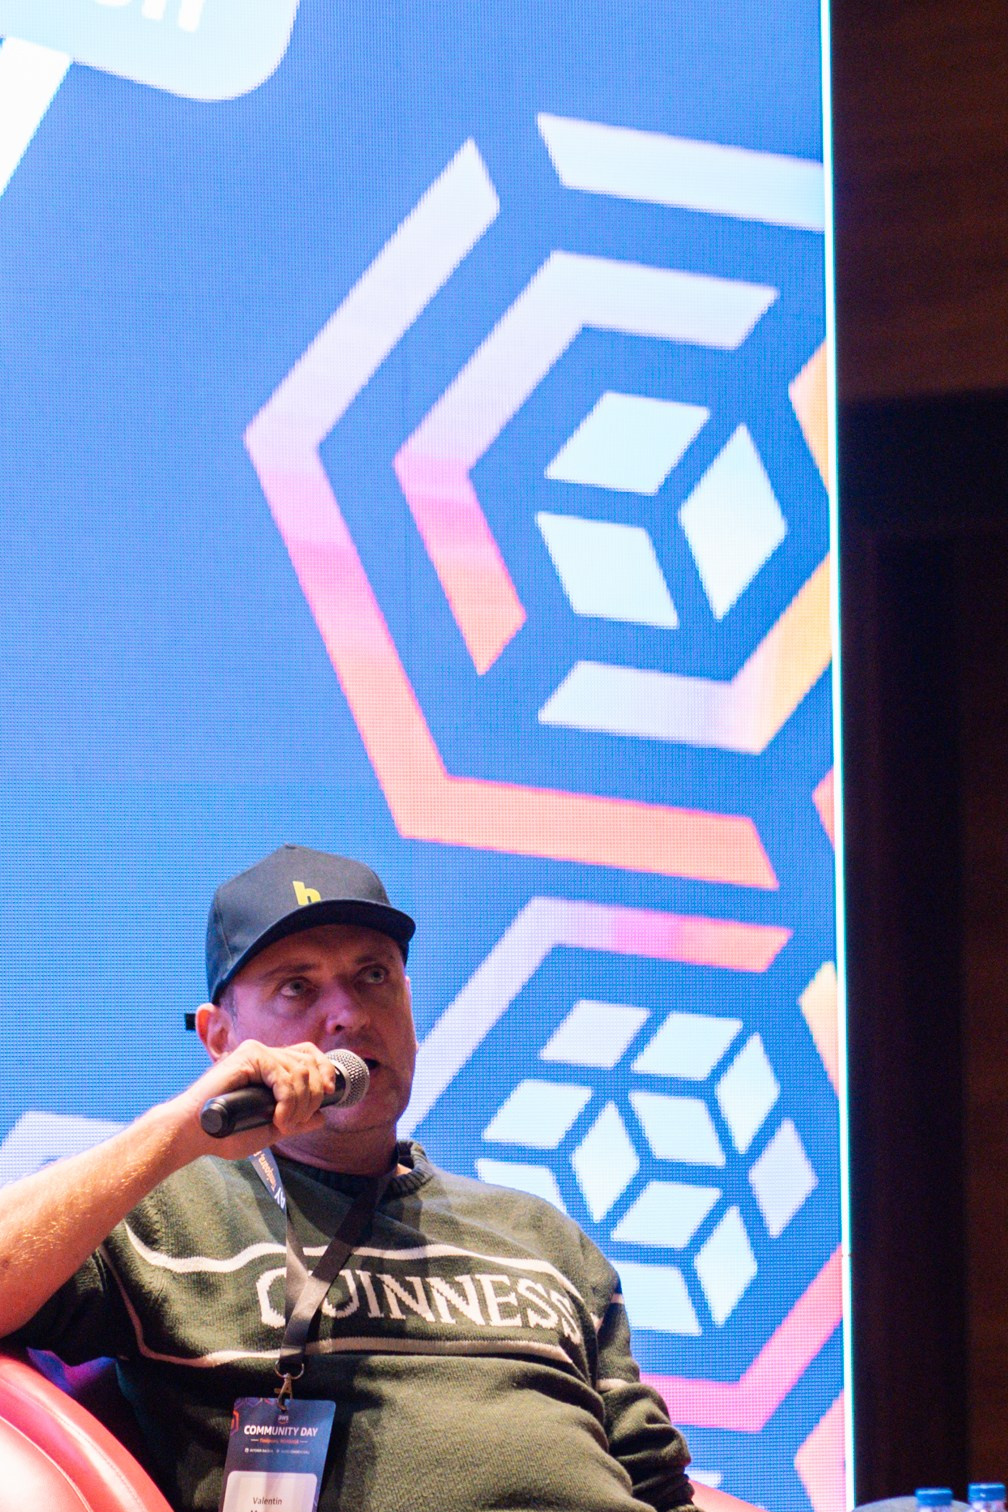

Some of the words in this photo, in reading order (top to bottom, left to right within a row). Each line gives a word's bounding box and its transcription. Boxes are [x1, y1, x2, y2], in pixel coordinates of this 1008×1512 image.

[244, 1425, 299, 1436] COMMUNITY
[300, 1427, 319, 1437] DAY
[252, 1497, 282, 1505] Valentin
